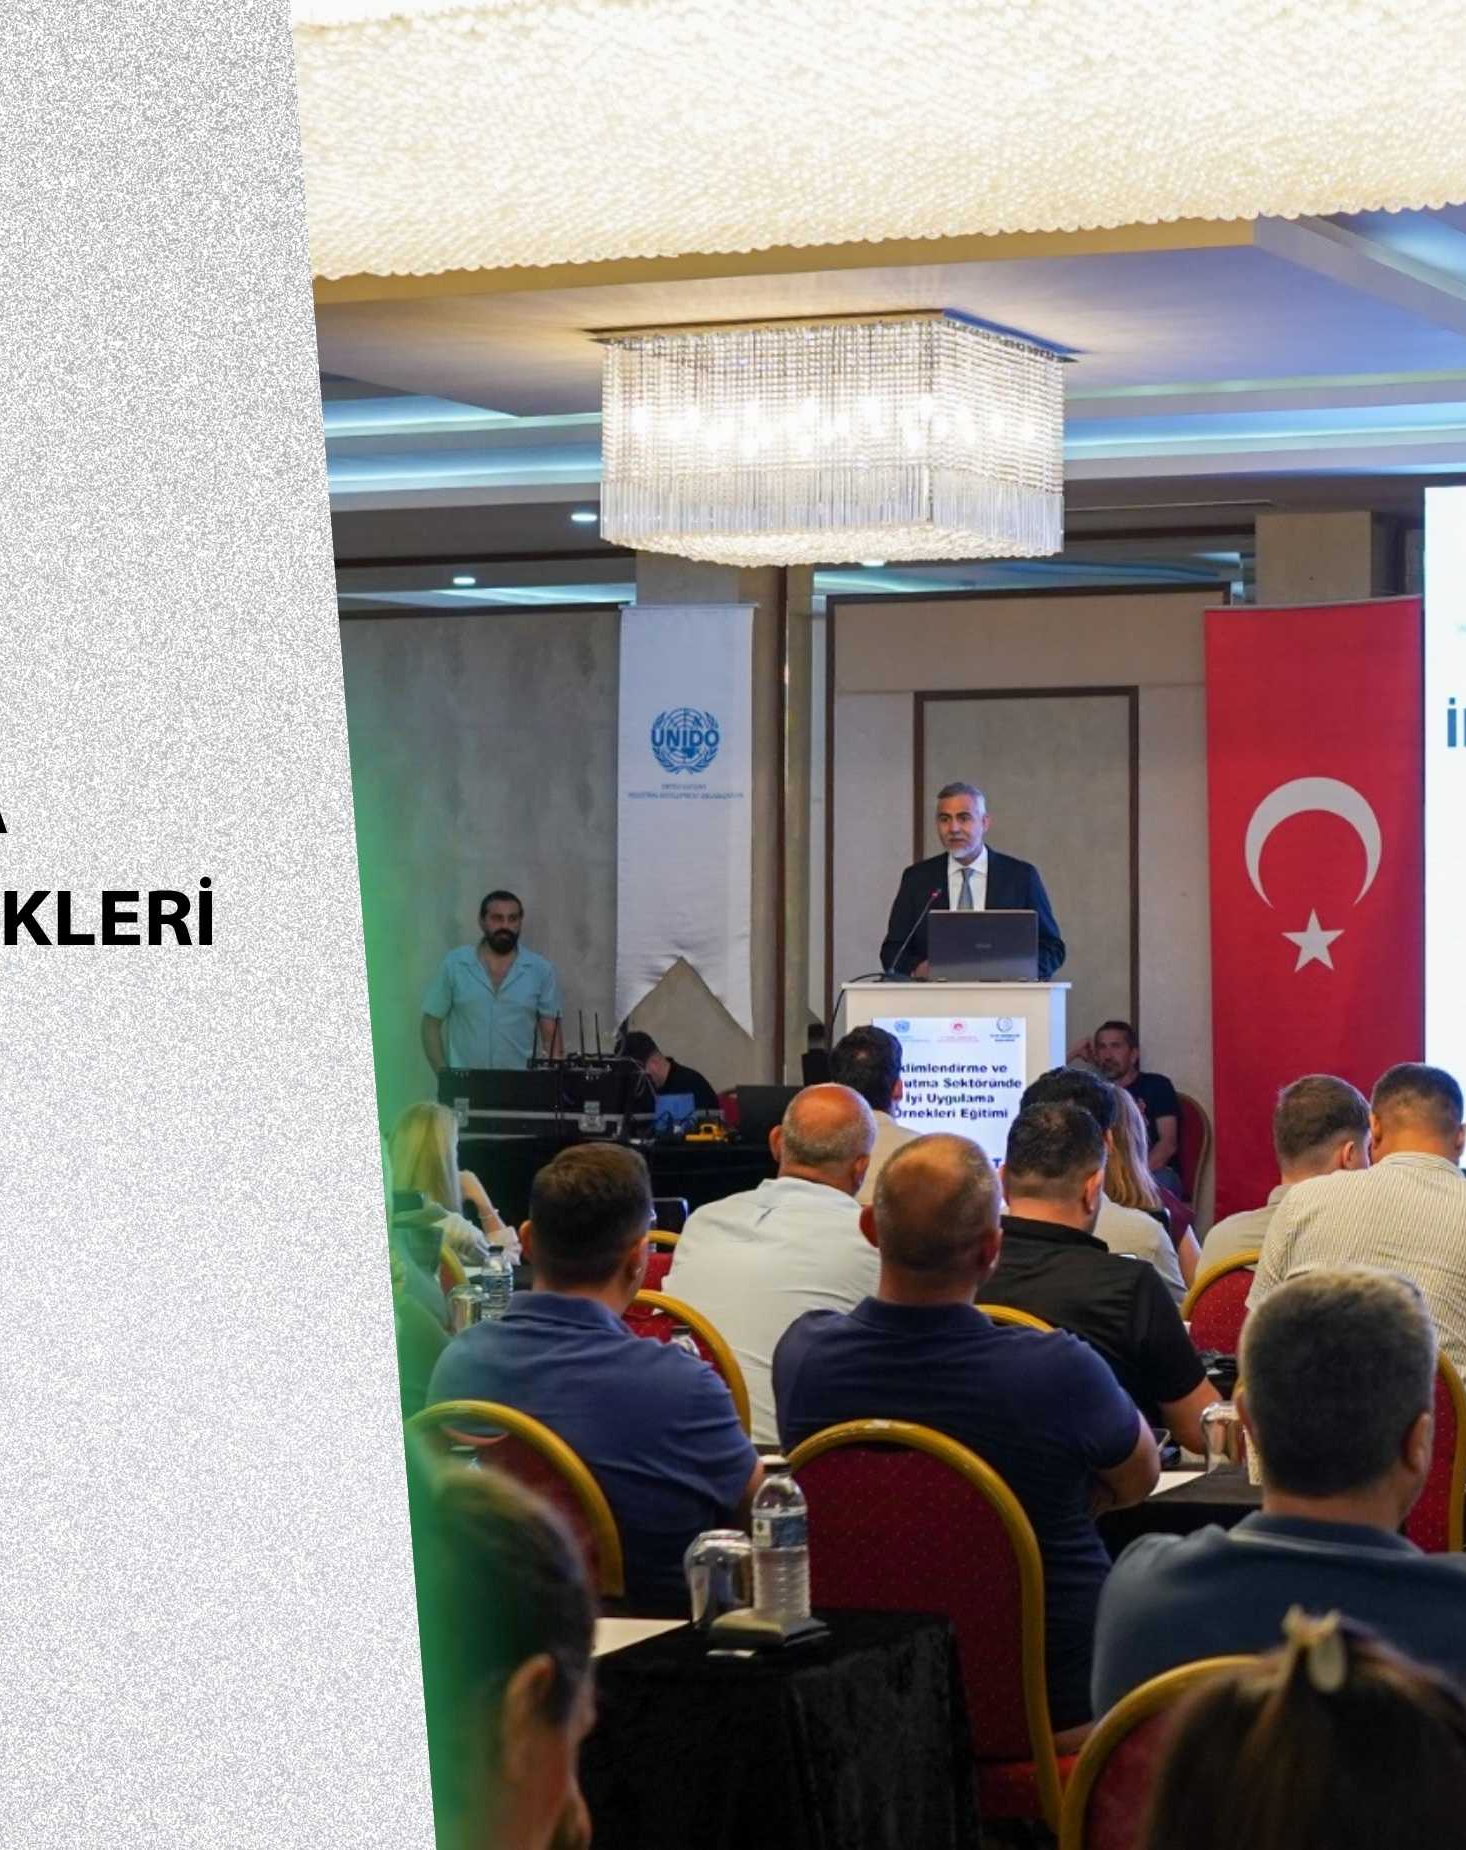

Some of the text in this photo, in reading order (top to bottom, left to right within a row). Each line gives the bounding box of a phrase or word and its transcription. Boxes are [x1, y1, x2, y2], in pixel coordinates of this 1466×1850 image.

[651, 729, 720, 747] UNIDO
[992, 1065, 1008, 1074] ve
[927, 1093, 995, 1106] Uygulama
